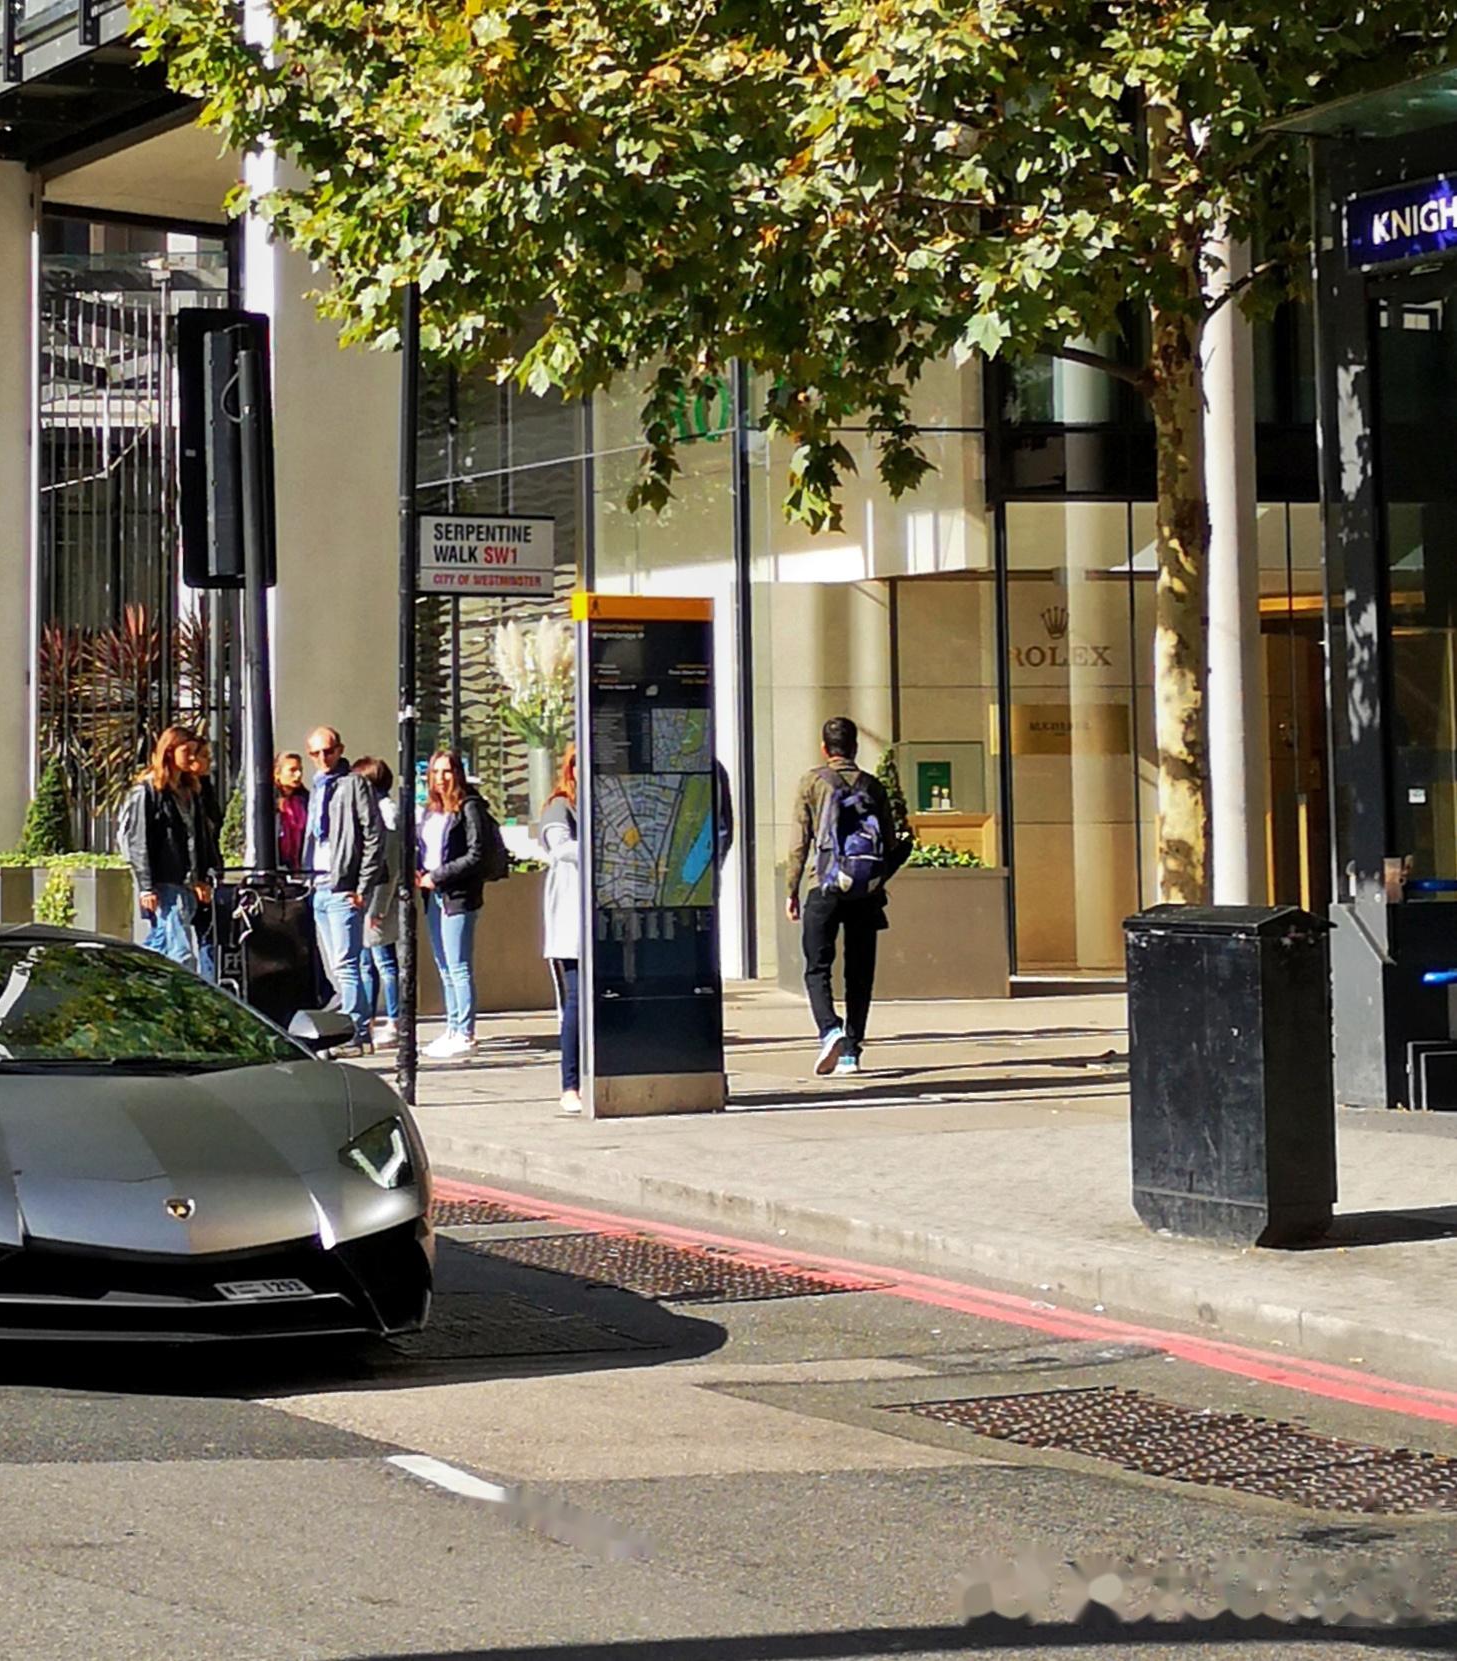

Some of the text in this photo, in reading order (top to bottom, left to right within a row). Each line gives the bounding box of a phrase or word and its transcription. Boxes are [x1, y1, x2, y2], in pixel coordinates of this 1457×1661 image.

[1373, 195, 1457, 245] KNIGH
[433, 523, 532, 543] SERPENTINE
[433, 545, 517, 564] WALK SW1
[433, 573, 541, 587] CITY OF WESTMINSTER
